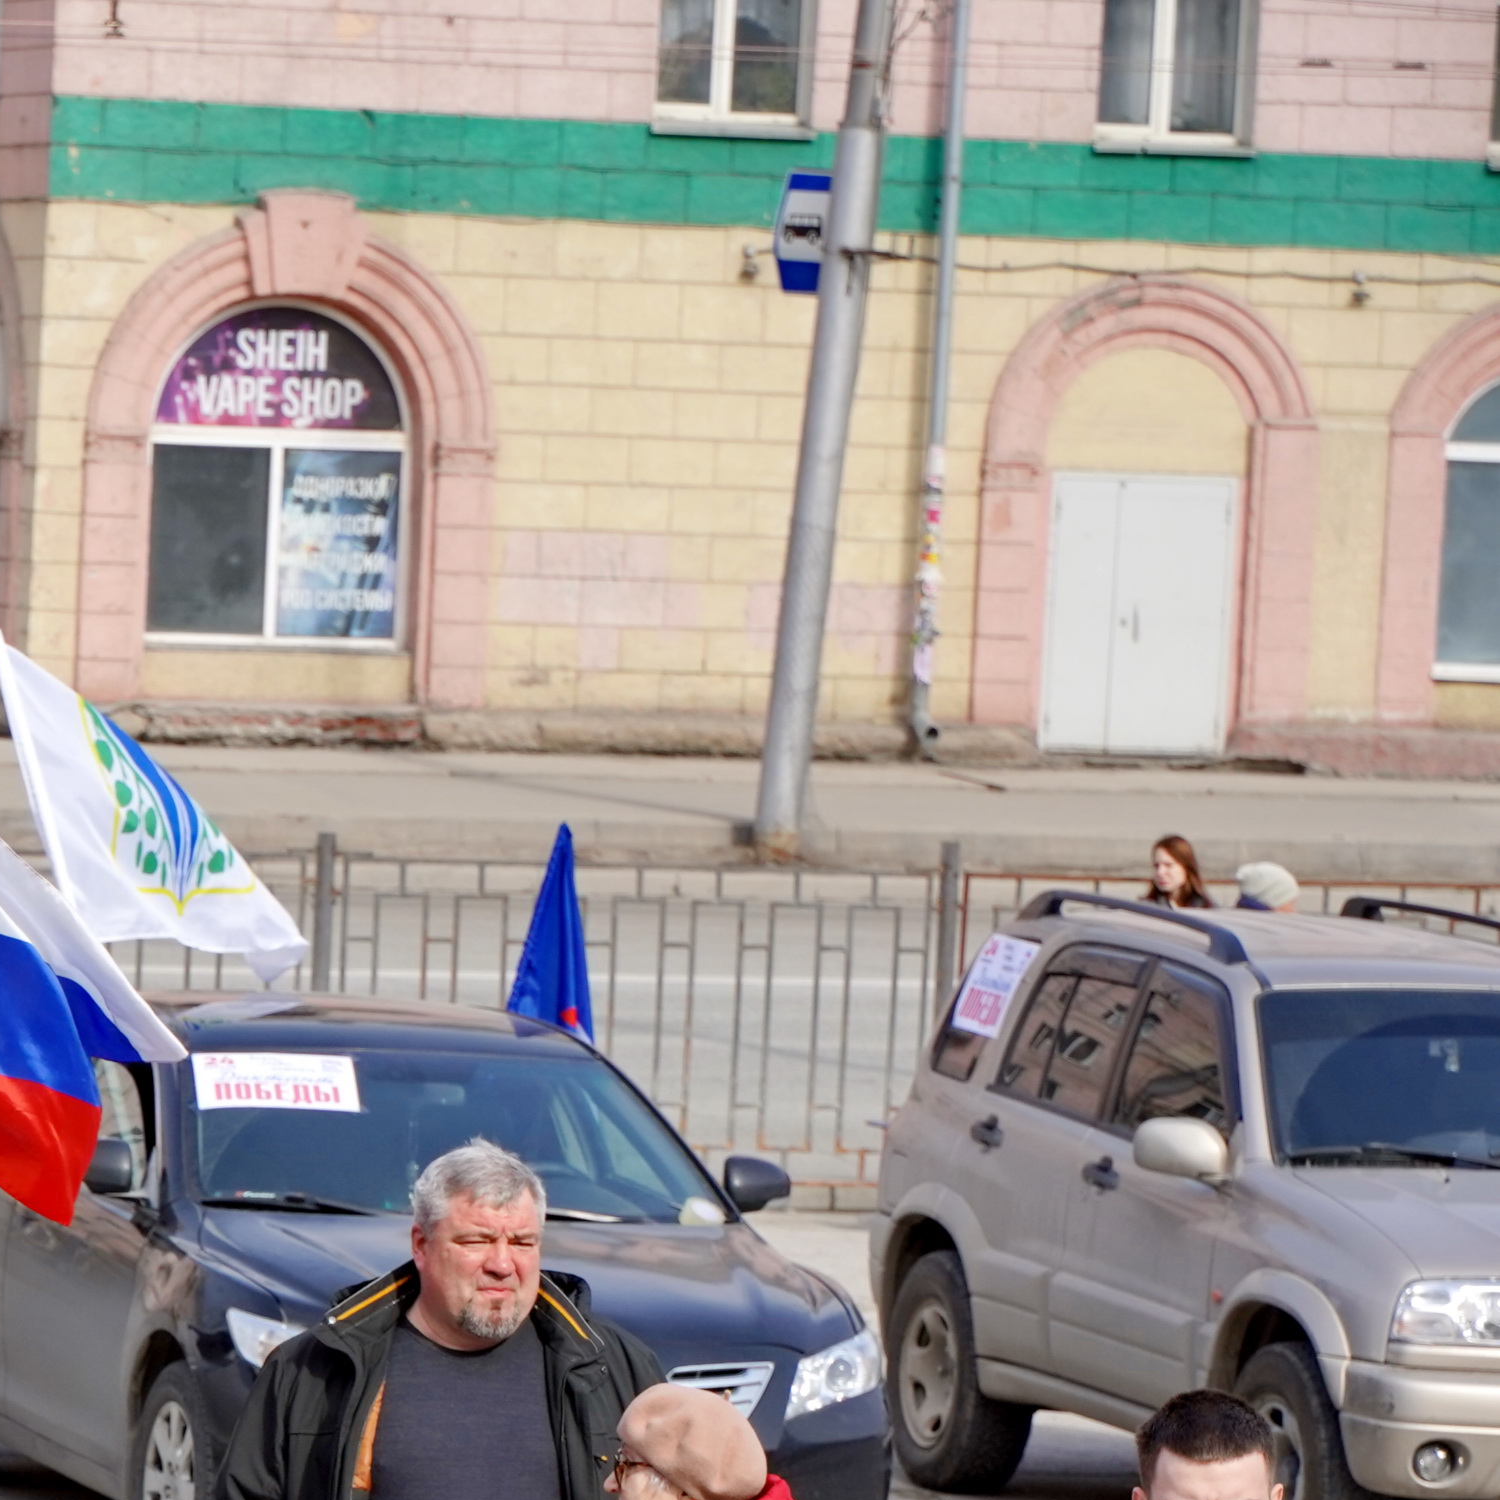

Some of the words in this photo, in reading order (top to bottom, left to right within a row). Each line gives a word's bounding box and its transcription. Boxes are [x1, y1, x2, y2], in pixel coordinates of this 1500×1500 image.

[235, 327, 330, 371] SHEIH
[195, 373, 276, 418] VAPE
[280, 376, 364, 420] SHOP
[214, 1083, 341, 1103] ПОБЕДЫ
